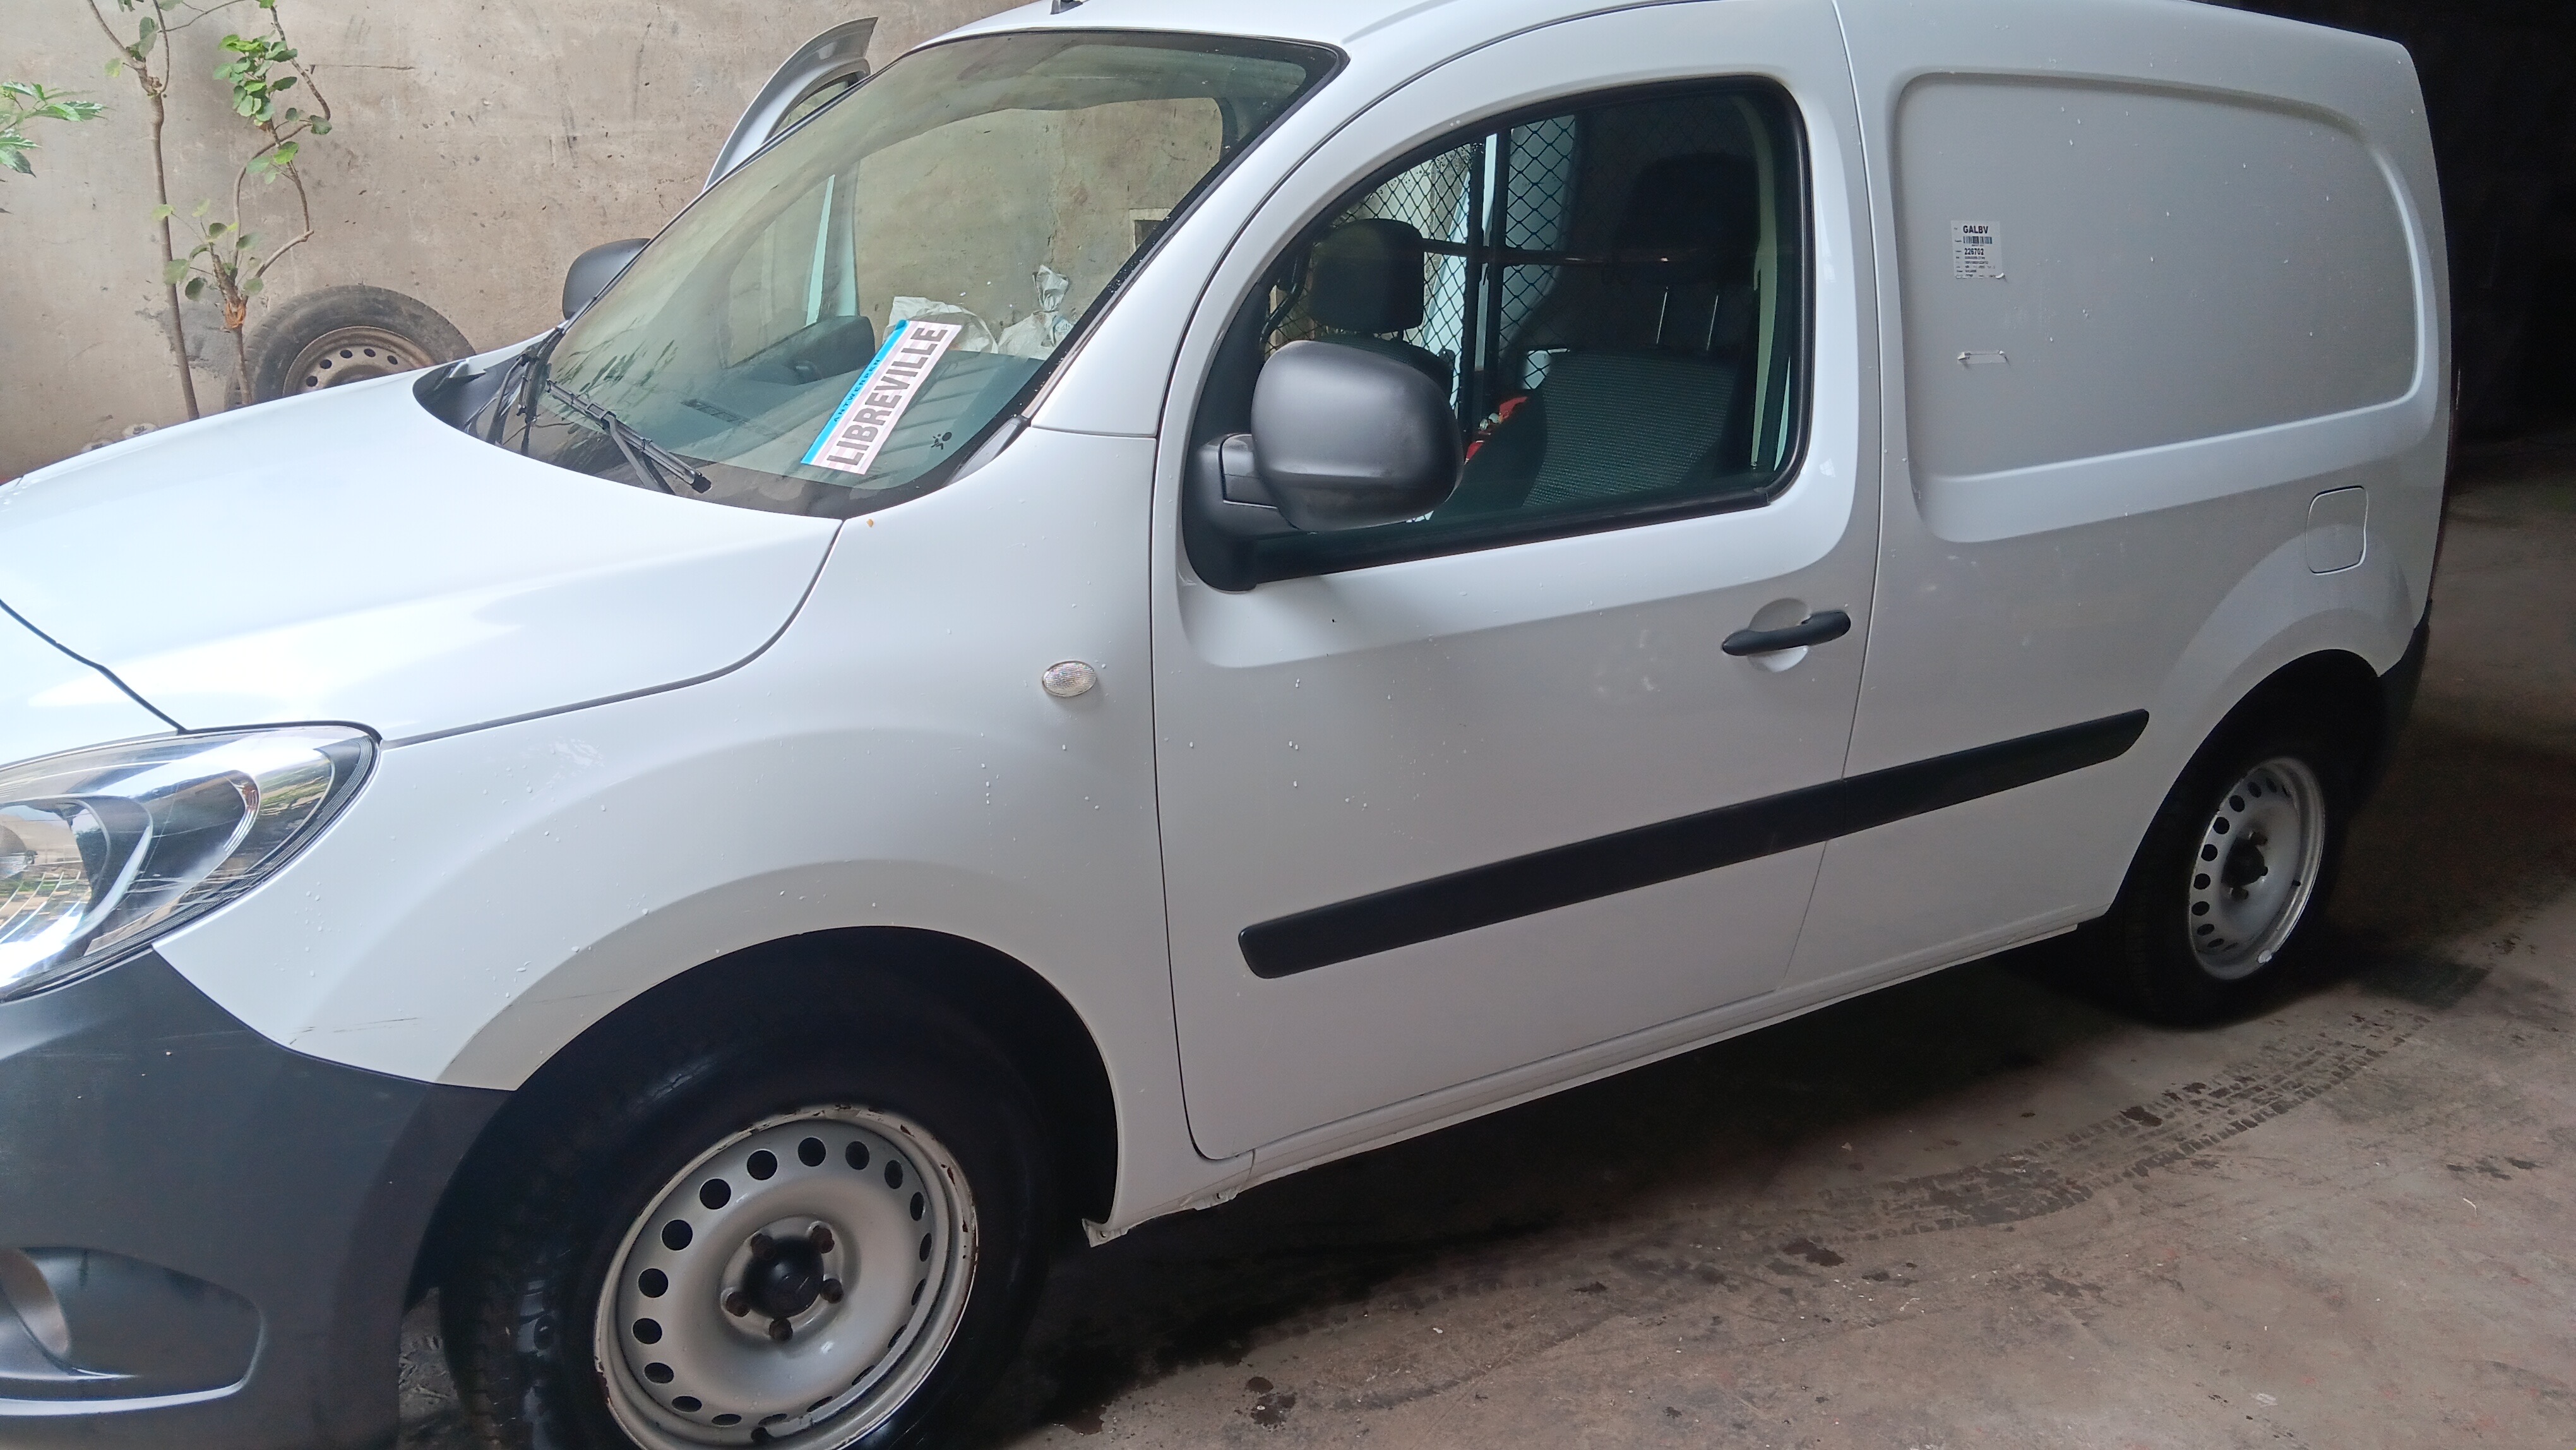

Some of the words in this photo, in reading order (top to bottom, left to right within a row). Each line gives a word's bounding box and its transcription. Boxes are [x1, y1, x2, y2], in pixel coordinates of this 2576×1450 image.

[1963, 225, 1988, 234] GALBV
[826, 327, 948, 466] LIBREVILLE
[833, 359, 881, 422] ANTWERPEN
